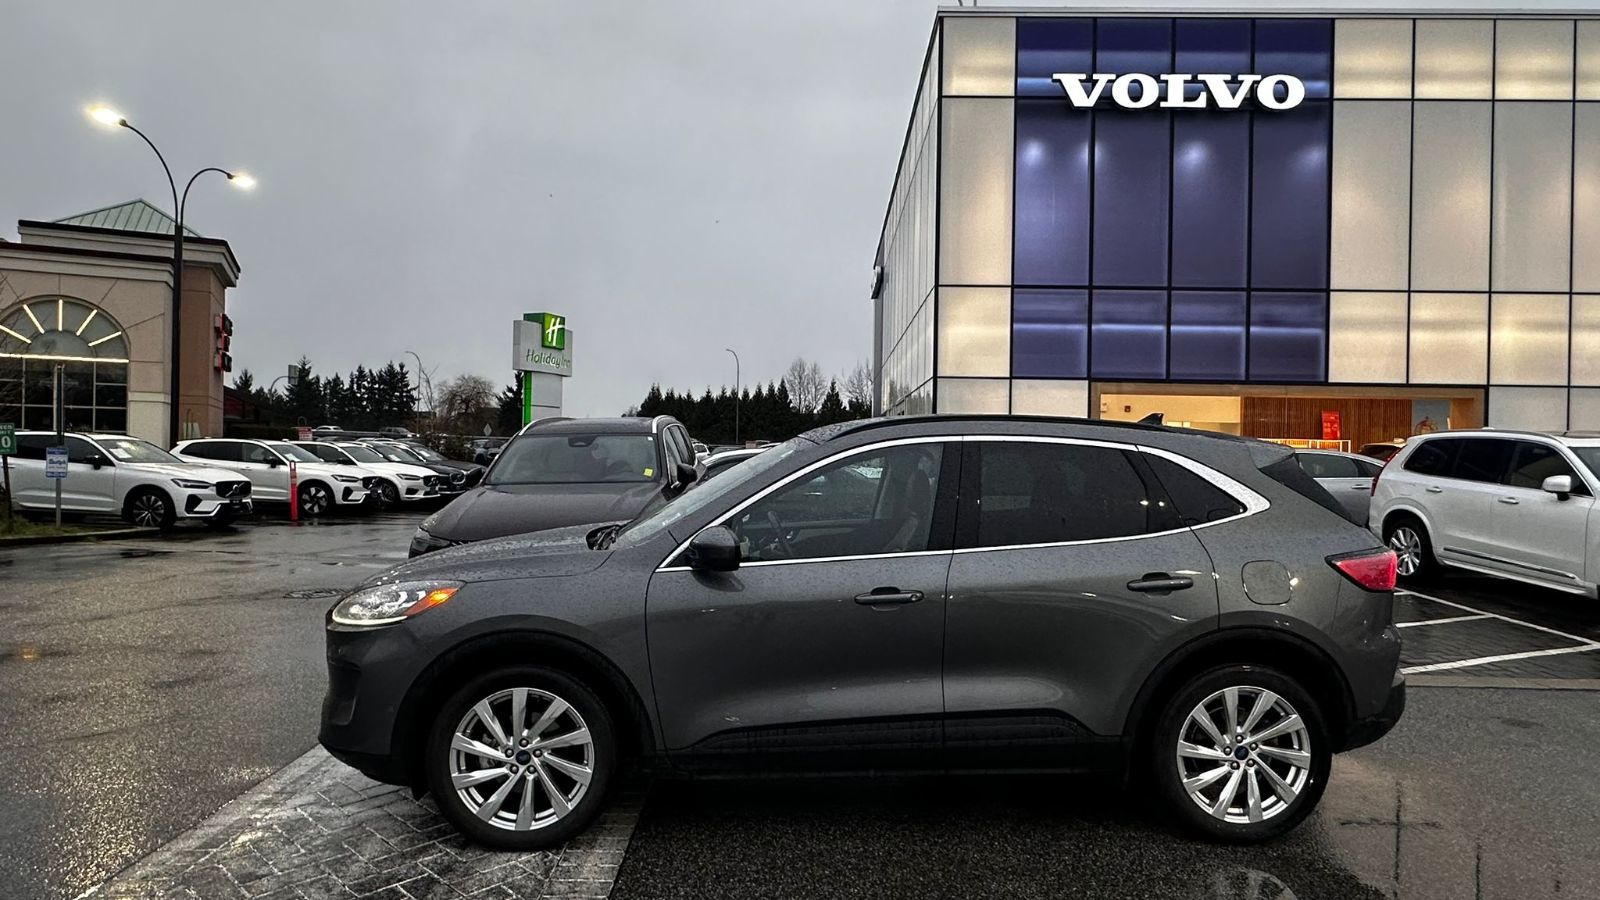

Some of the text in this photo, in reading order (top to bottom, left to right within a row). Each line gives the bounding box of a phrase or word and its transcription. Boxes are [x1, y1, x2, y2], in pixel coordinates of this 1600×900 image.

[1052, 73, 1305, 110] VOLVO
[526, 349, 571, 369] Holiday Inn
